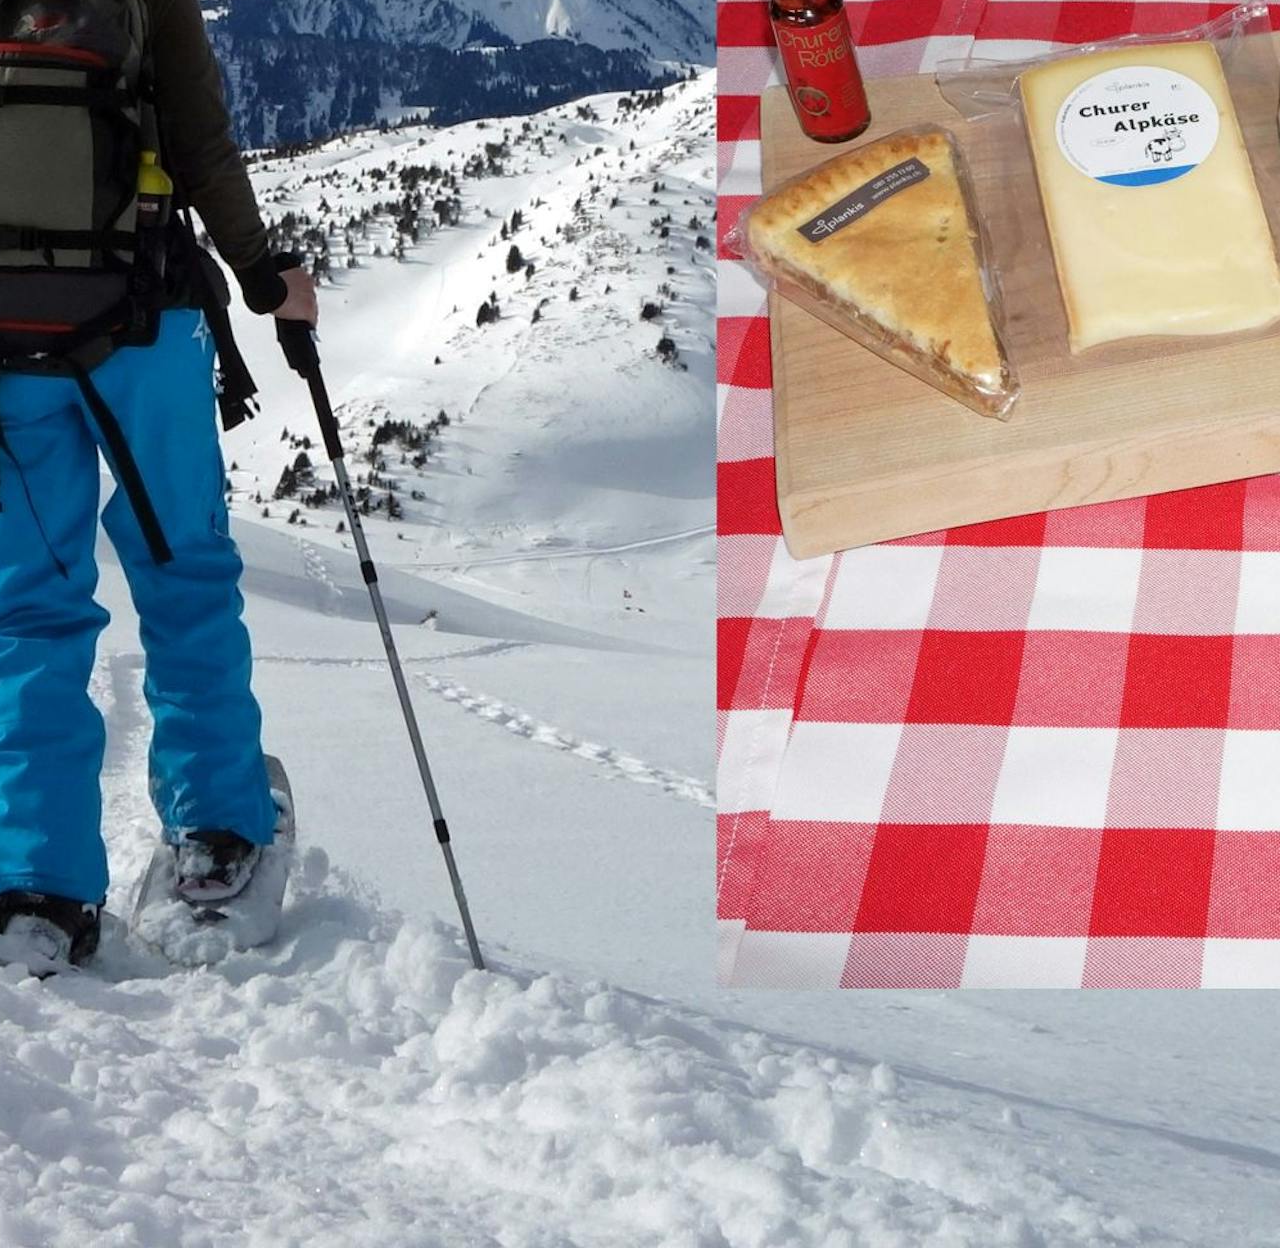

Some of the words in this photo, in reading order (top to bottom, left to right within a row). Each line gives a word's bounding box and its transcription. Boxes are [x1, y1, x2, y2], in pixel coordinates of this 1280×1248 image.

[779, 22, 846, 49] Churer
[1079, 101, 1150, 118] Churer
[1114, 113, 1200, 132] Alpkäse
[827, 202, 865, 231] plankis
